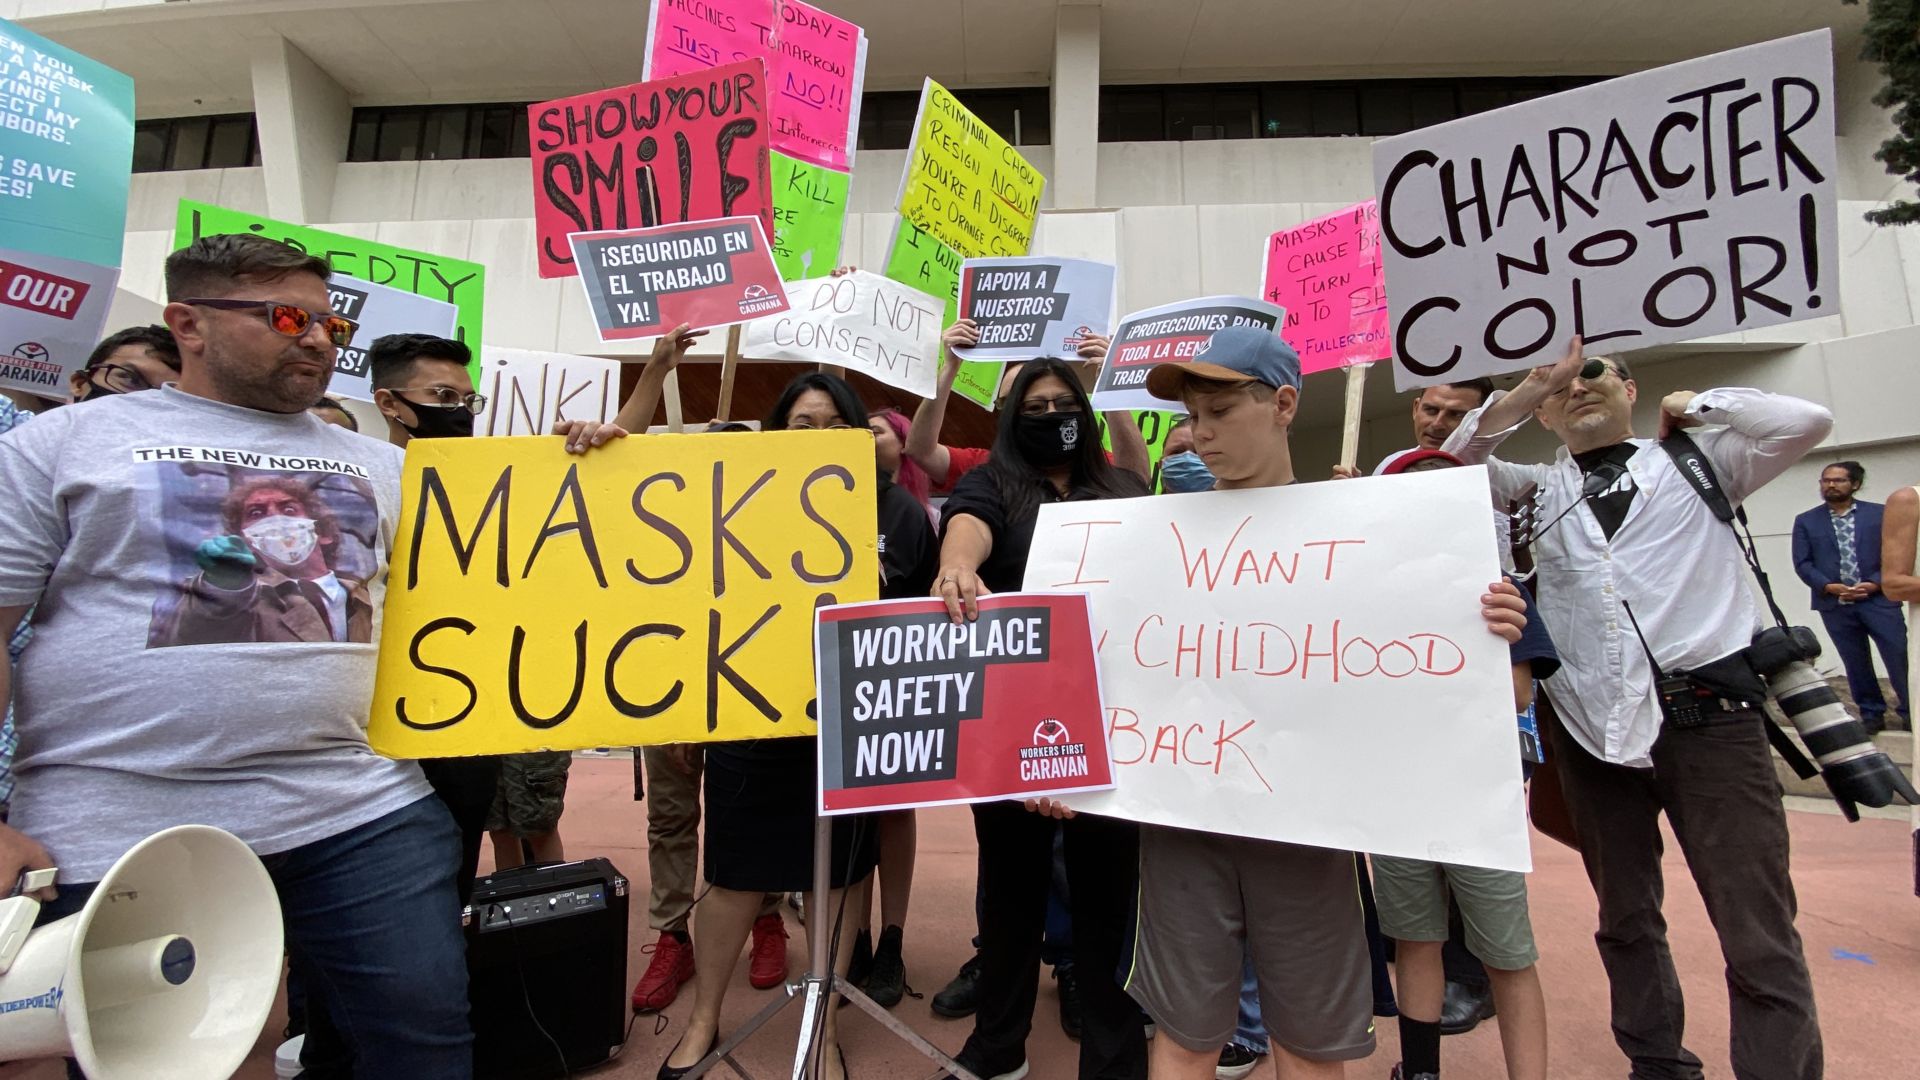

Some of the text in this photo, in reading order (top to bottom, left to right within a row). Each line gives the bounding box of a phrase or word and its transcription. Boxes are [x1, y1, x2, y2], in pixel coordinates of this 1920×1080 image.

[9, 54, 95, 95] A MASK
[32, 50, 74, 75] YOU
[673, 25, 844, 112] JUST NO!!
[18, 70, 62, 95] ARE
[46, 108, 81, 130] MY
[54, 96, 61, 108] I
[538, 73, 761, 152] SHOW YOUR
[931, 89, 991, 149] CRIMINAL
[930, 119, 981, 175] RESIGN
[12, 157, 77, 188] SAVE
[788, 164, 835, 205] KILL
[1381, 76, 1825, 259] CHARACTER
[923, 183, 941, 212] TO
[947, 201, 985, 245] ORANGE
[973, 189, 982, 213] A
[989, 201, 1030, 250] DISGRACE
[601, 235, 717, 267] ¡SEGURIDAD
[723, 230, 748, 252] EN
[906, 224, 927, 249] I
[1275, 217, 1337, 252] MASKS
[1496, 209, 1709, 290] NOT
[919, 261, 931, 283] A
[1287, 241, 1348, 273] CAUSE
[7, 274, 76, 312] OUR
[608, 262, 727, 295] EL TRABAJO
[976, 271, 1029, 292] ¡APOYA
[1034, 270, 1047, 289] A
[1296, 272, 1350, 297] TURN
[1395, 193, 1823, 377] COLOR!
[617, 301, 651, 324] YA!
[739, 298, 783, 315] CARAVANA
[809, 279, 855, 313] DO
[872, 288, 935, 340] NOT
[973, 297, 1055, 318] NUESTROS
[1307, 299, 1331, 322] TO
[1126, 314, 1228, 340] ¡PROTECCIONES
[773, 318, 921, 378] CONSENT
[1119, 345, 1151, 362] TODA
[1153, 343, 1169, 358] LA
[0, 364, 60, 386] ARAVAN
[136, 447, 369, 479] THE NEW NORMAL
[1687, 458, 1713, 491] Canon
[407, 459, 857, 599] MASKS
[1051, 515, 1366, 592] I WANT
[852, 617, 1042, 668] WORKPLACE
[853, 671, 975, 722] SAFETY
[855, 728, 945, 778] NOW!
[1020, 743, 1084, 760] WORKERS FIRST
[1104, 706, 1273, 793] BACK
[1020, 756, 1089, 781] CARAVAN
